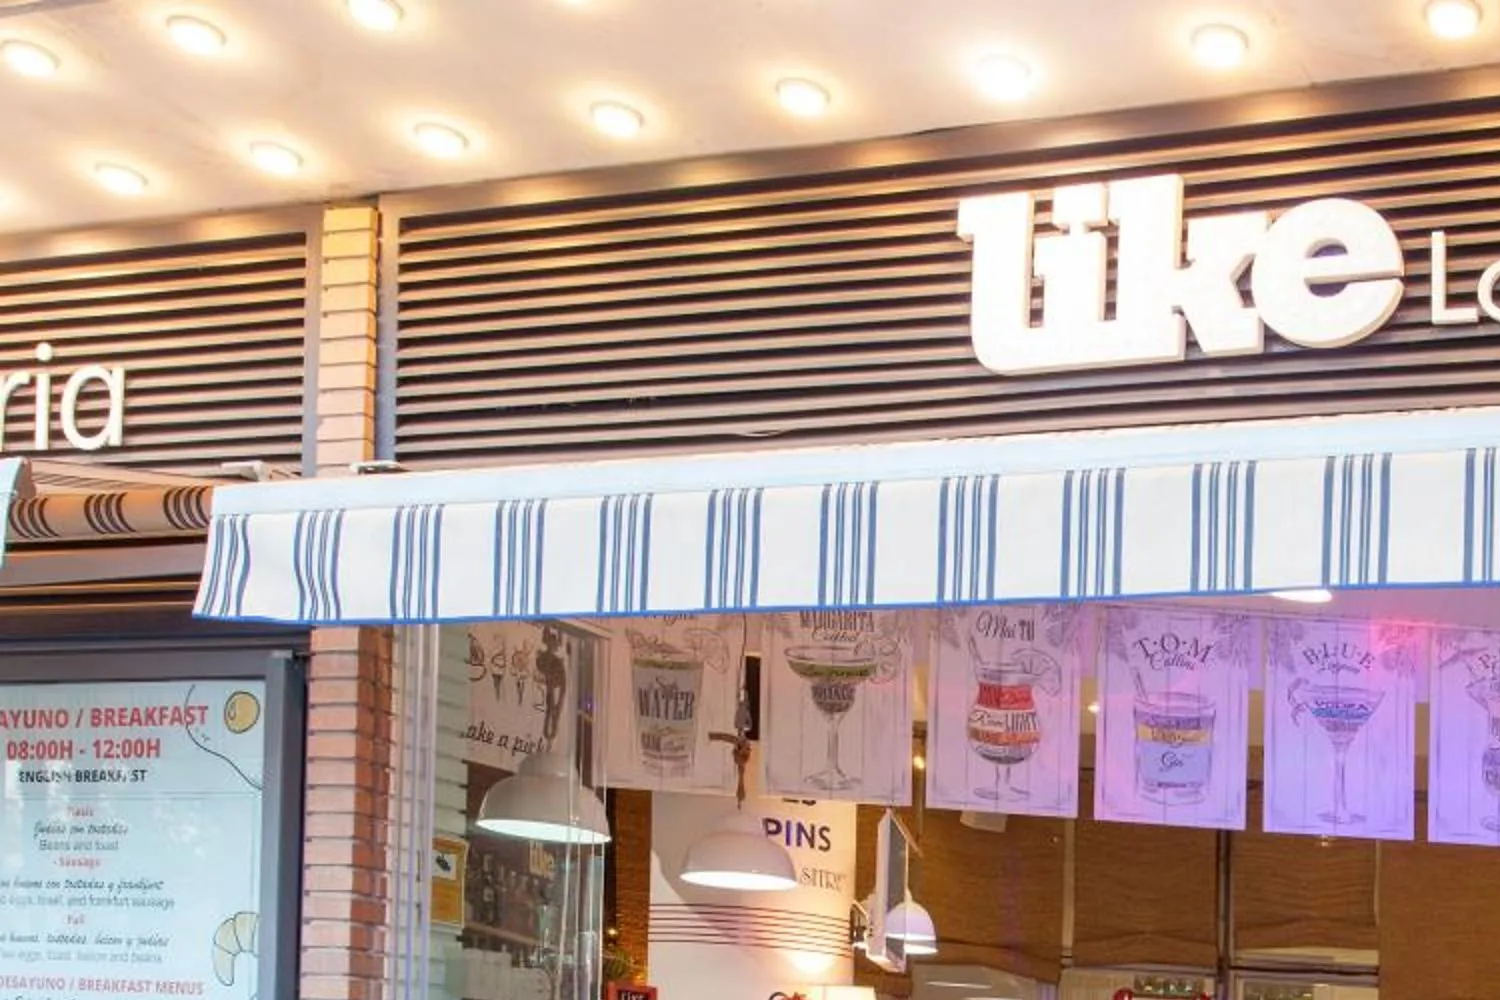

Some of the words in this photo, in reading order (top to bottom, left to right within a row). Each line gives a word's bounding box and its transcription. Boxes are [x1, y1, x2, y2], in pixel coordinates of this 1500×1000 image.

[90, 705, 209, 728] BREAKFAST
[7, 740, 73, 761] 08:00H
[92, 738, 161, 759] 12:00H
[762, 816, 831, 852] PINS
[79, 978, 150, 994] BREAKFAST
[156, 981, 205, 996] MENUS
